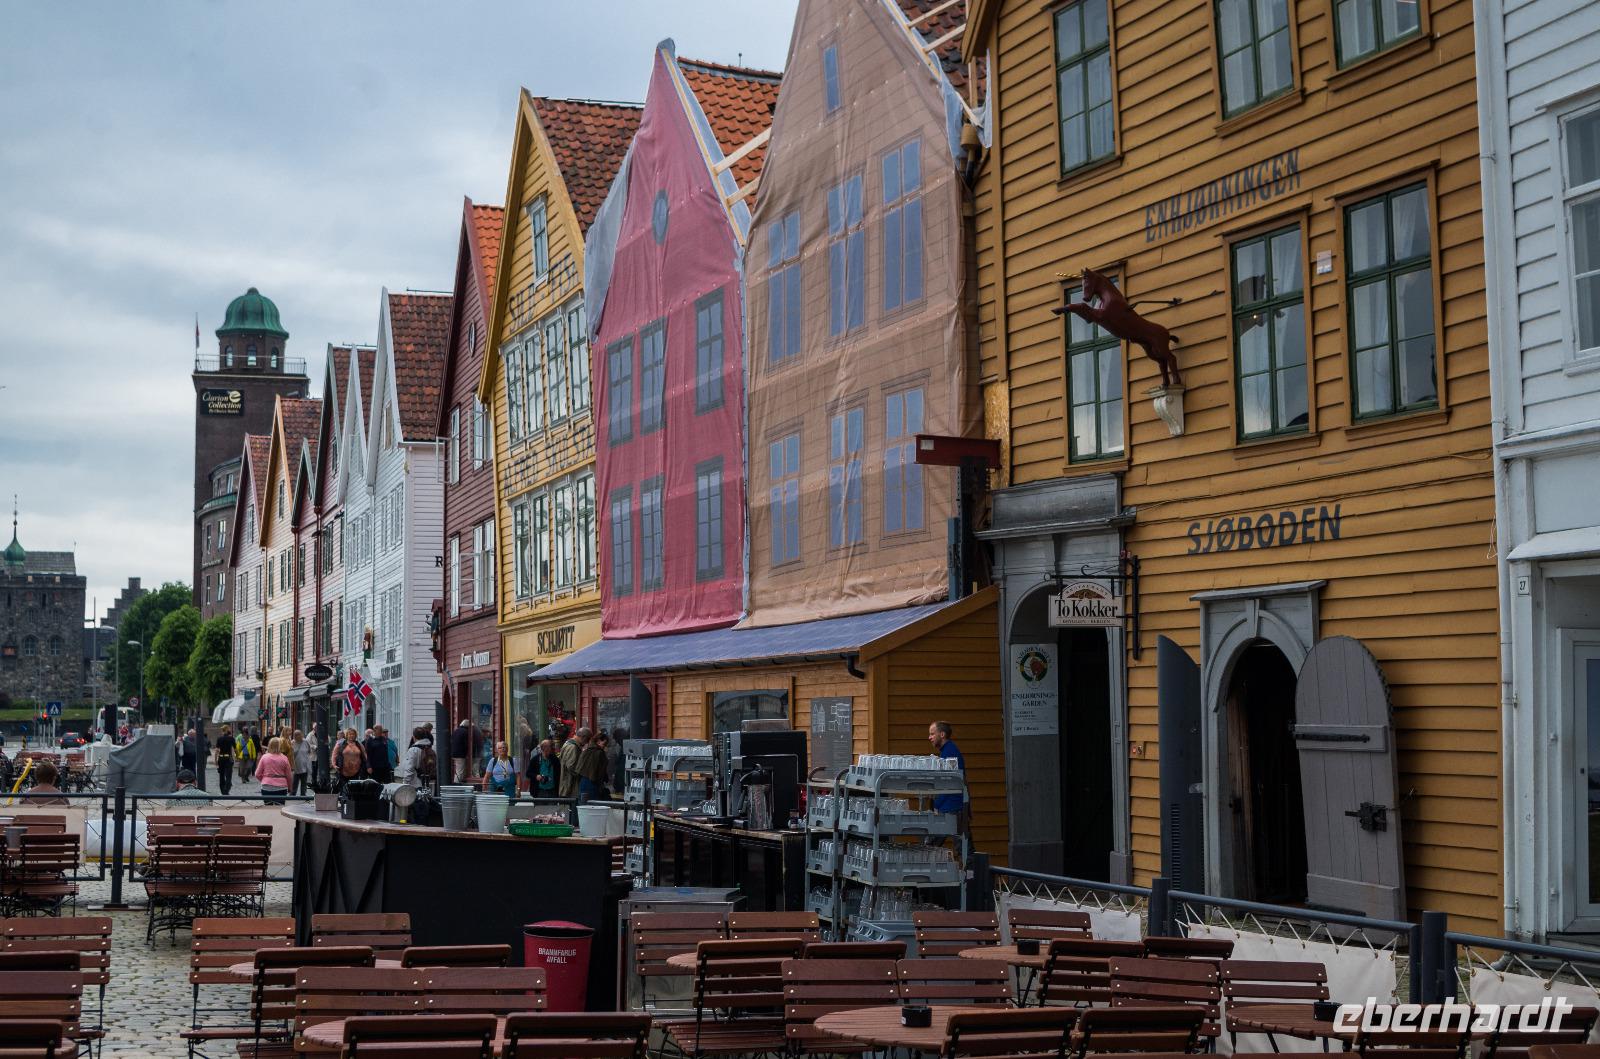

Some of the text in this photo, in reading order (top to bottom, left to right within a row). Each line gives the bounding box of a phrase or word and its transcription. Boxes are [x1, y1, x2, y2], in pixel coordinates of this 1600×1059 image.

[544, 423, 594, 477] SKULSTA
[1187, 504, 1341, 555] SJØBODEN
[1055, 600, 1118, 618] To Kokker
